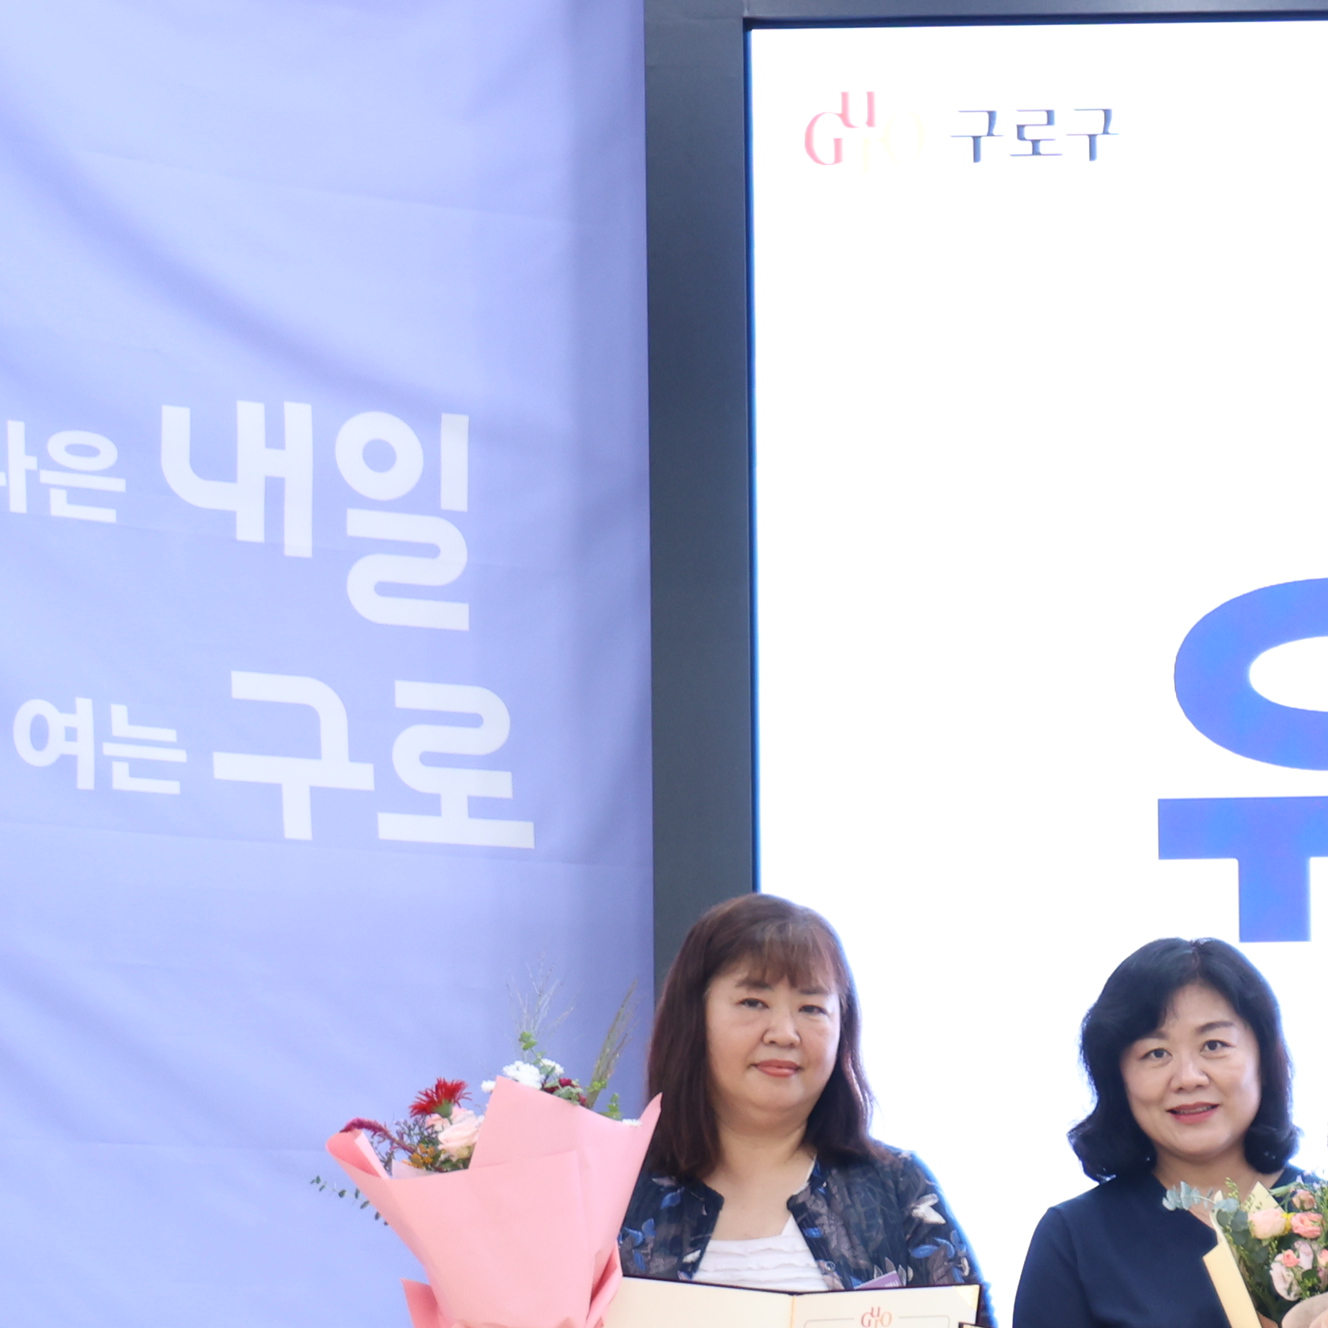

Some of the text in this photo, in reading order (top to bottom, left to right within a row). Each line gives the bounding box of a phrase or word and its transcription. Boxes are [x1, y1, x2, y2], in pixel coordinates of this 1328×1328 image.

[950, 108, 1120, 163] 구로구
[161, 400, 470, 631] 내일
[13, 670, 535, 849] 여는 구로
